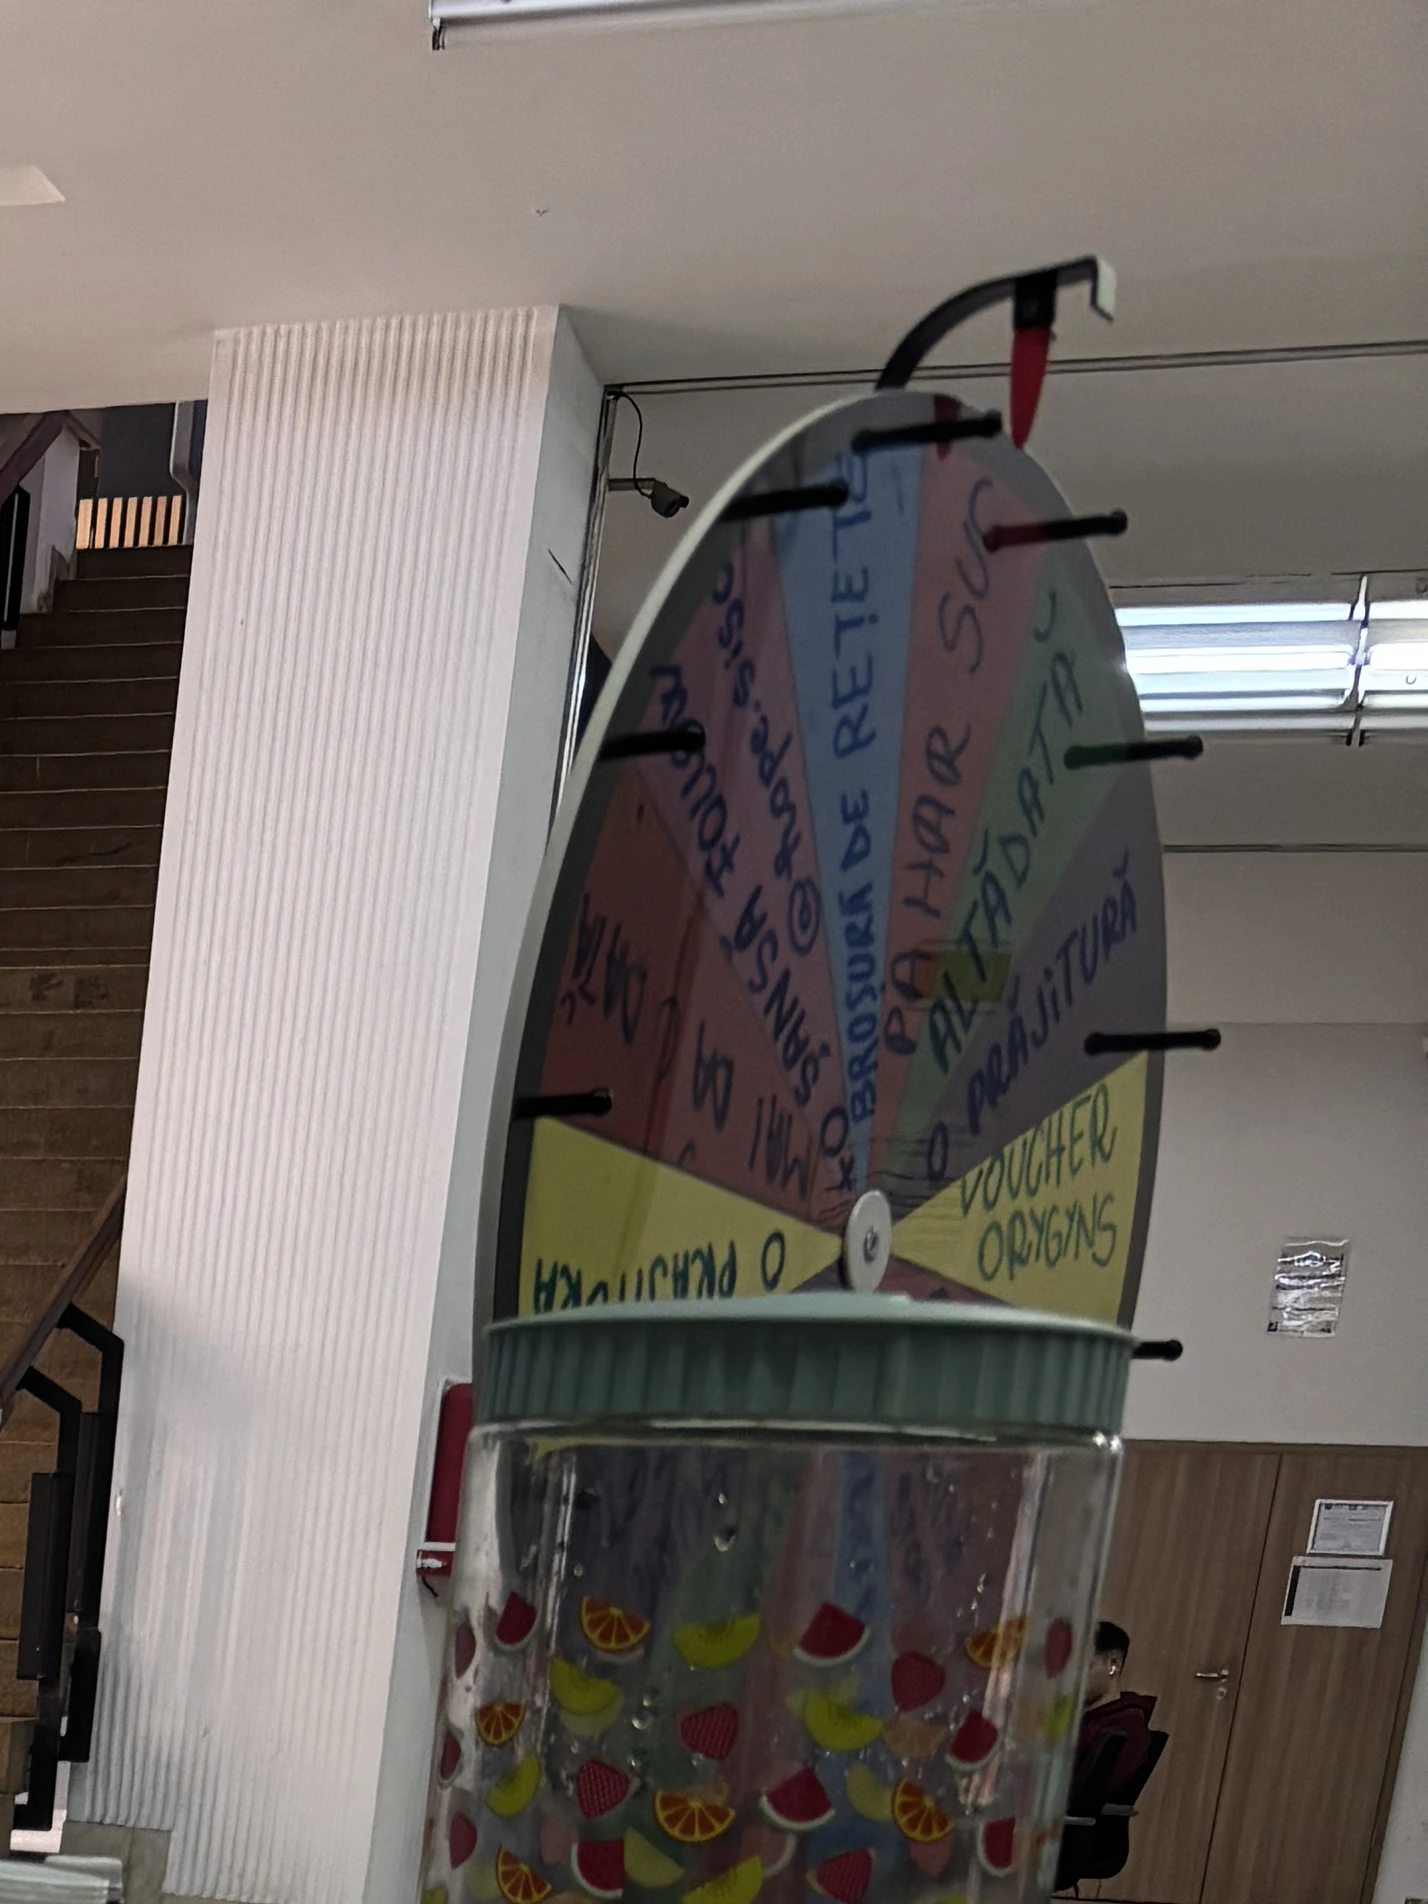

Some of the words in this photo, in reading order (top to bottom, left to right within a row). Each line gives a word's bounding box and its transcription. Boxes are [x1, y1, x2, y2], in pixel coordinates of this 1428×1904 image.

[841, 788, 873, 872] DE
[927, 1120, 948, 1184] O
[961, 1082, 1118, 1218] VOUCHER
[759, 1232, 787, 1290] O
